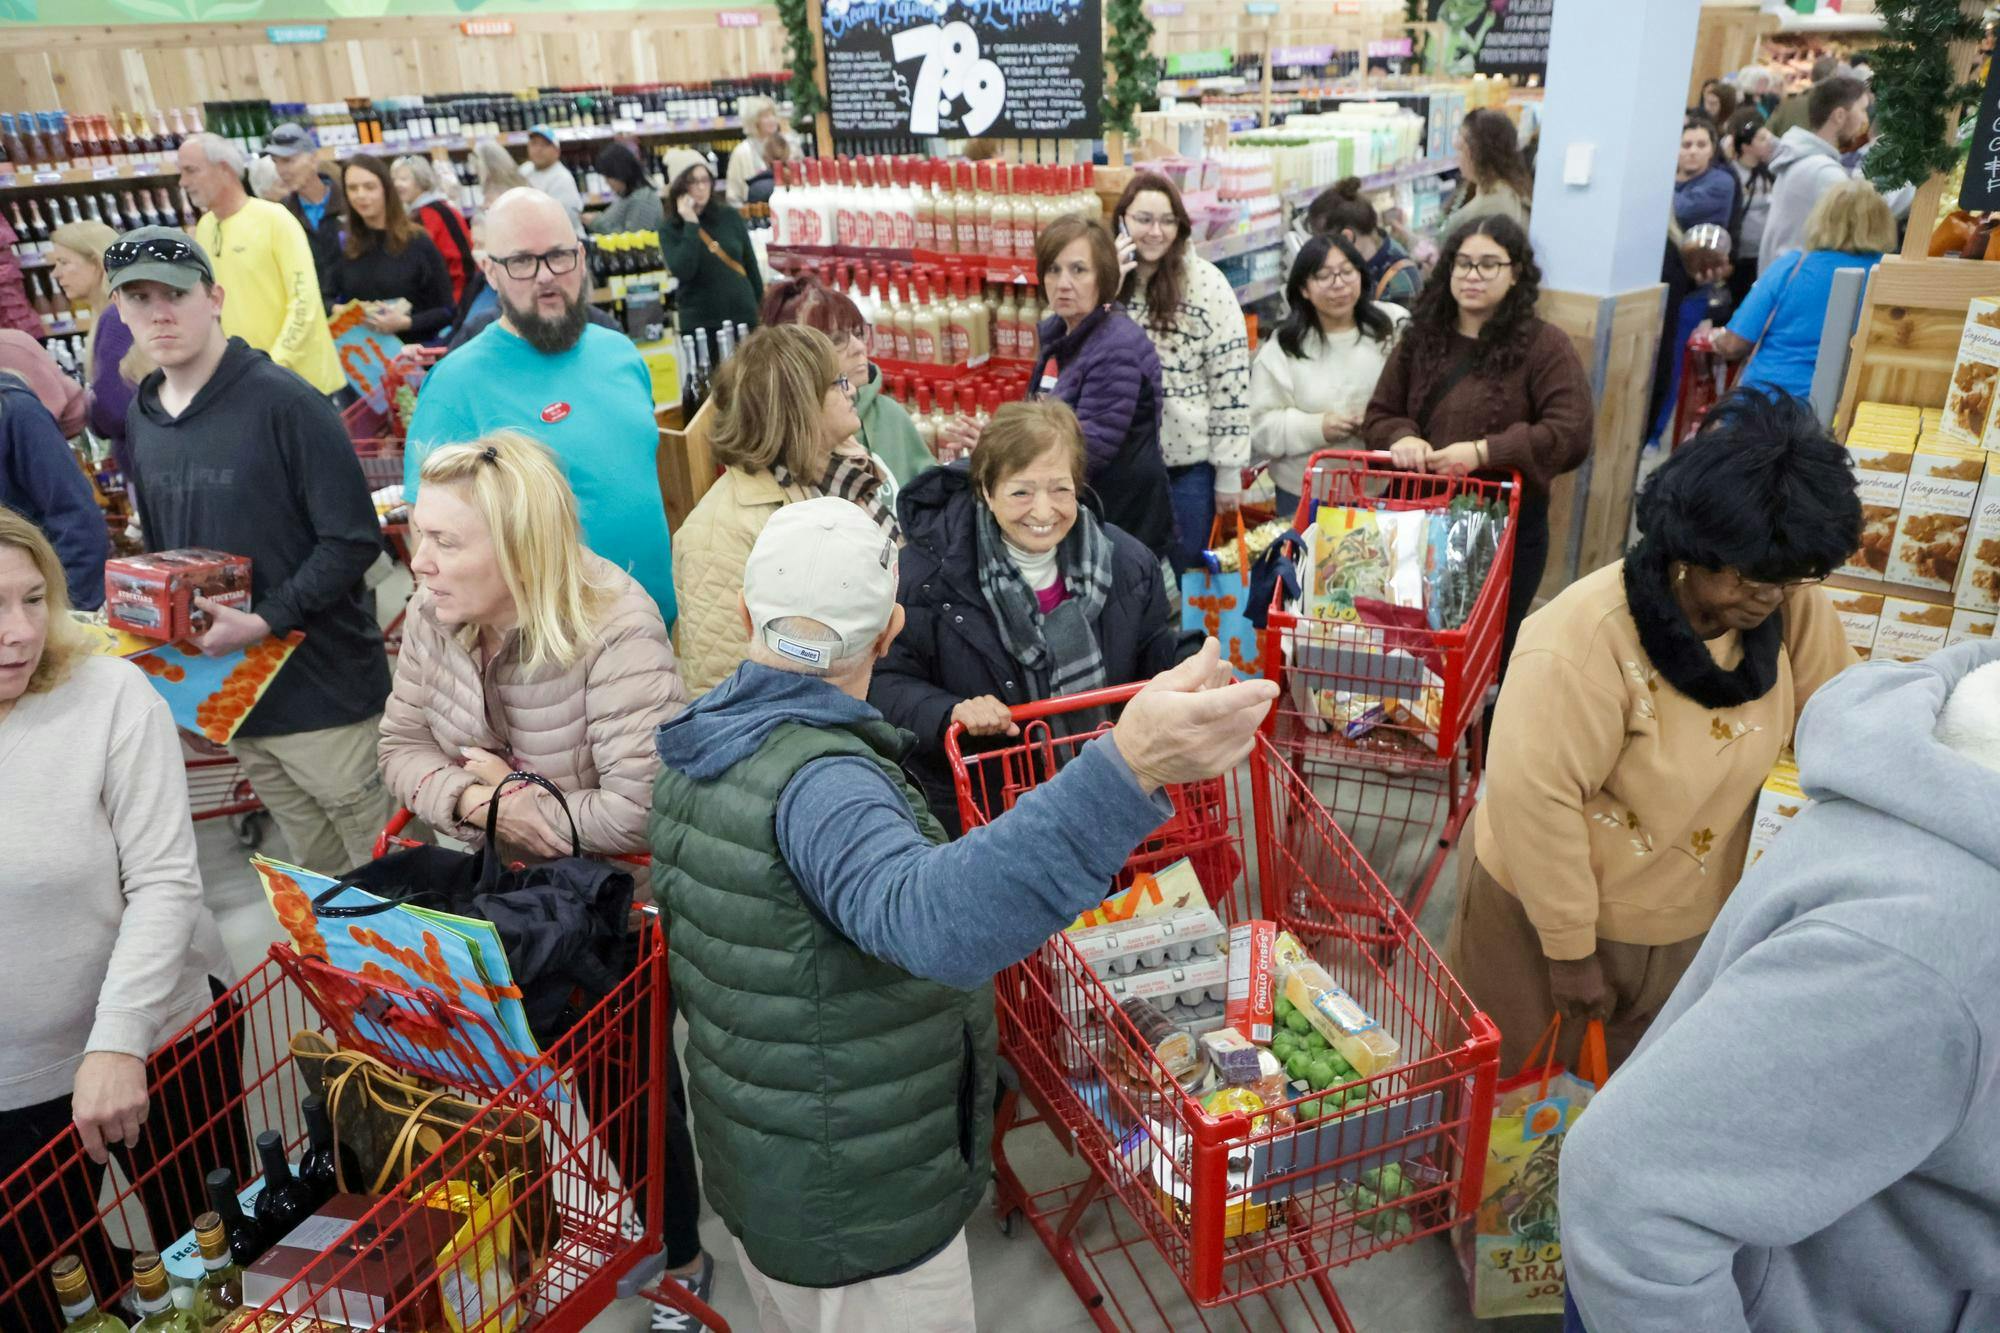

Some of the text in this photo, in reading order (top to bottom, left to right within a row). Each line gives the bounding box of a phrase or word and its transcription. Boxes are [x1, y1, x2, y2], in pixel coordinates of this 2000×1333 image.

[1909, 480, 1975, 498] Gingerbread
[118, 590, 153, 603] STOCKYARD
[1312, 604, 1358, 621] FLO
[1881, 625, 1944, 643] Gingerbread
[171, 1241, 200, 1262] Hei
[1490, 1242, 1562, 1269] FLO
[1508, 1262, 1564, 1283] TRA
[1526, 1284, 1564, 1298] JO
